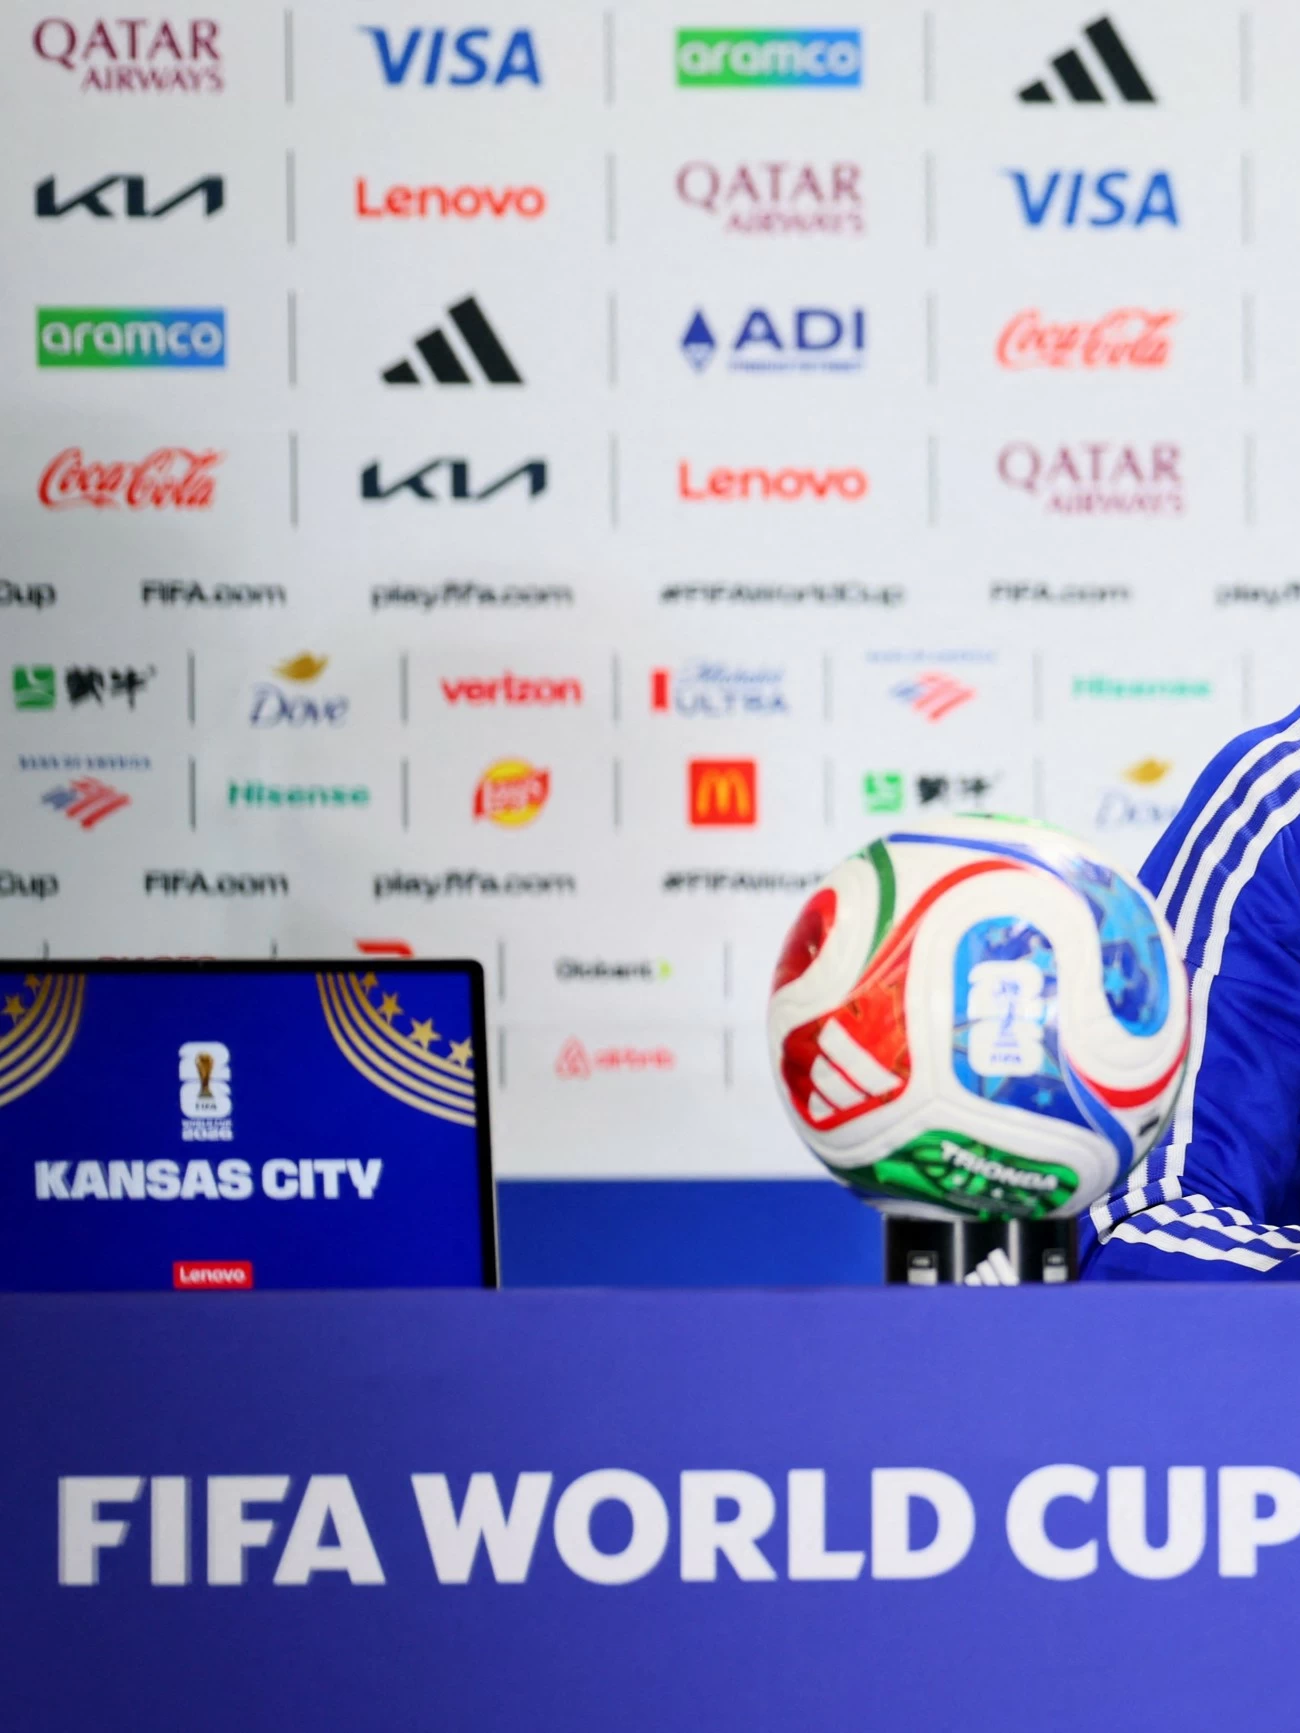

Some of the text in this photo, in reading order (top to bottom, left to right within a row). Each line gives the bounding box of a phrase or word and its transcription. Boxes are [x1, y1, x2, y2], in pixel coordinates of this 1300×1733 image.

[32, 18, 220, 69] QATAR
[360, 27, 542, 86] VISA
[679, 39, 859, 77] aramco
[82, 66, 223, 91] AIRWAYS
[35, 174, 224, 218] KIA
[356, 178, 546, 218] Lenovo
[675, 162, 862, 212] QATAR
[1003, 170, 1180, 228] VISA
[41, 321, 223, 357] aramco
[734, 308, 865, 351] ADI
[361, 459, 547, 501] KIA
[678, 461, 869, 501] Lenovo
[997, 443, 1181, 494] QATAR
[250, 683, 348, 726] Dove
[441, 670, 583, 706] verizon
[227, 780, 370, 808] Hisense
[35, 1158, 383, 1200] KANSAS CITY
[180, 1267, 246, 1283] Lenovo
[58, 1473, 387, 1586] FIFA
[410, 1467, 976, 1585] WORLD
